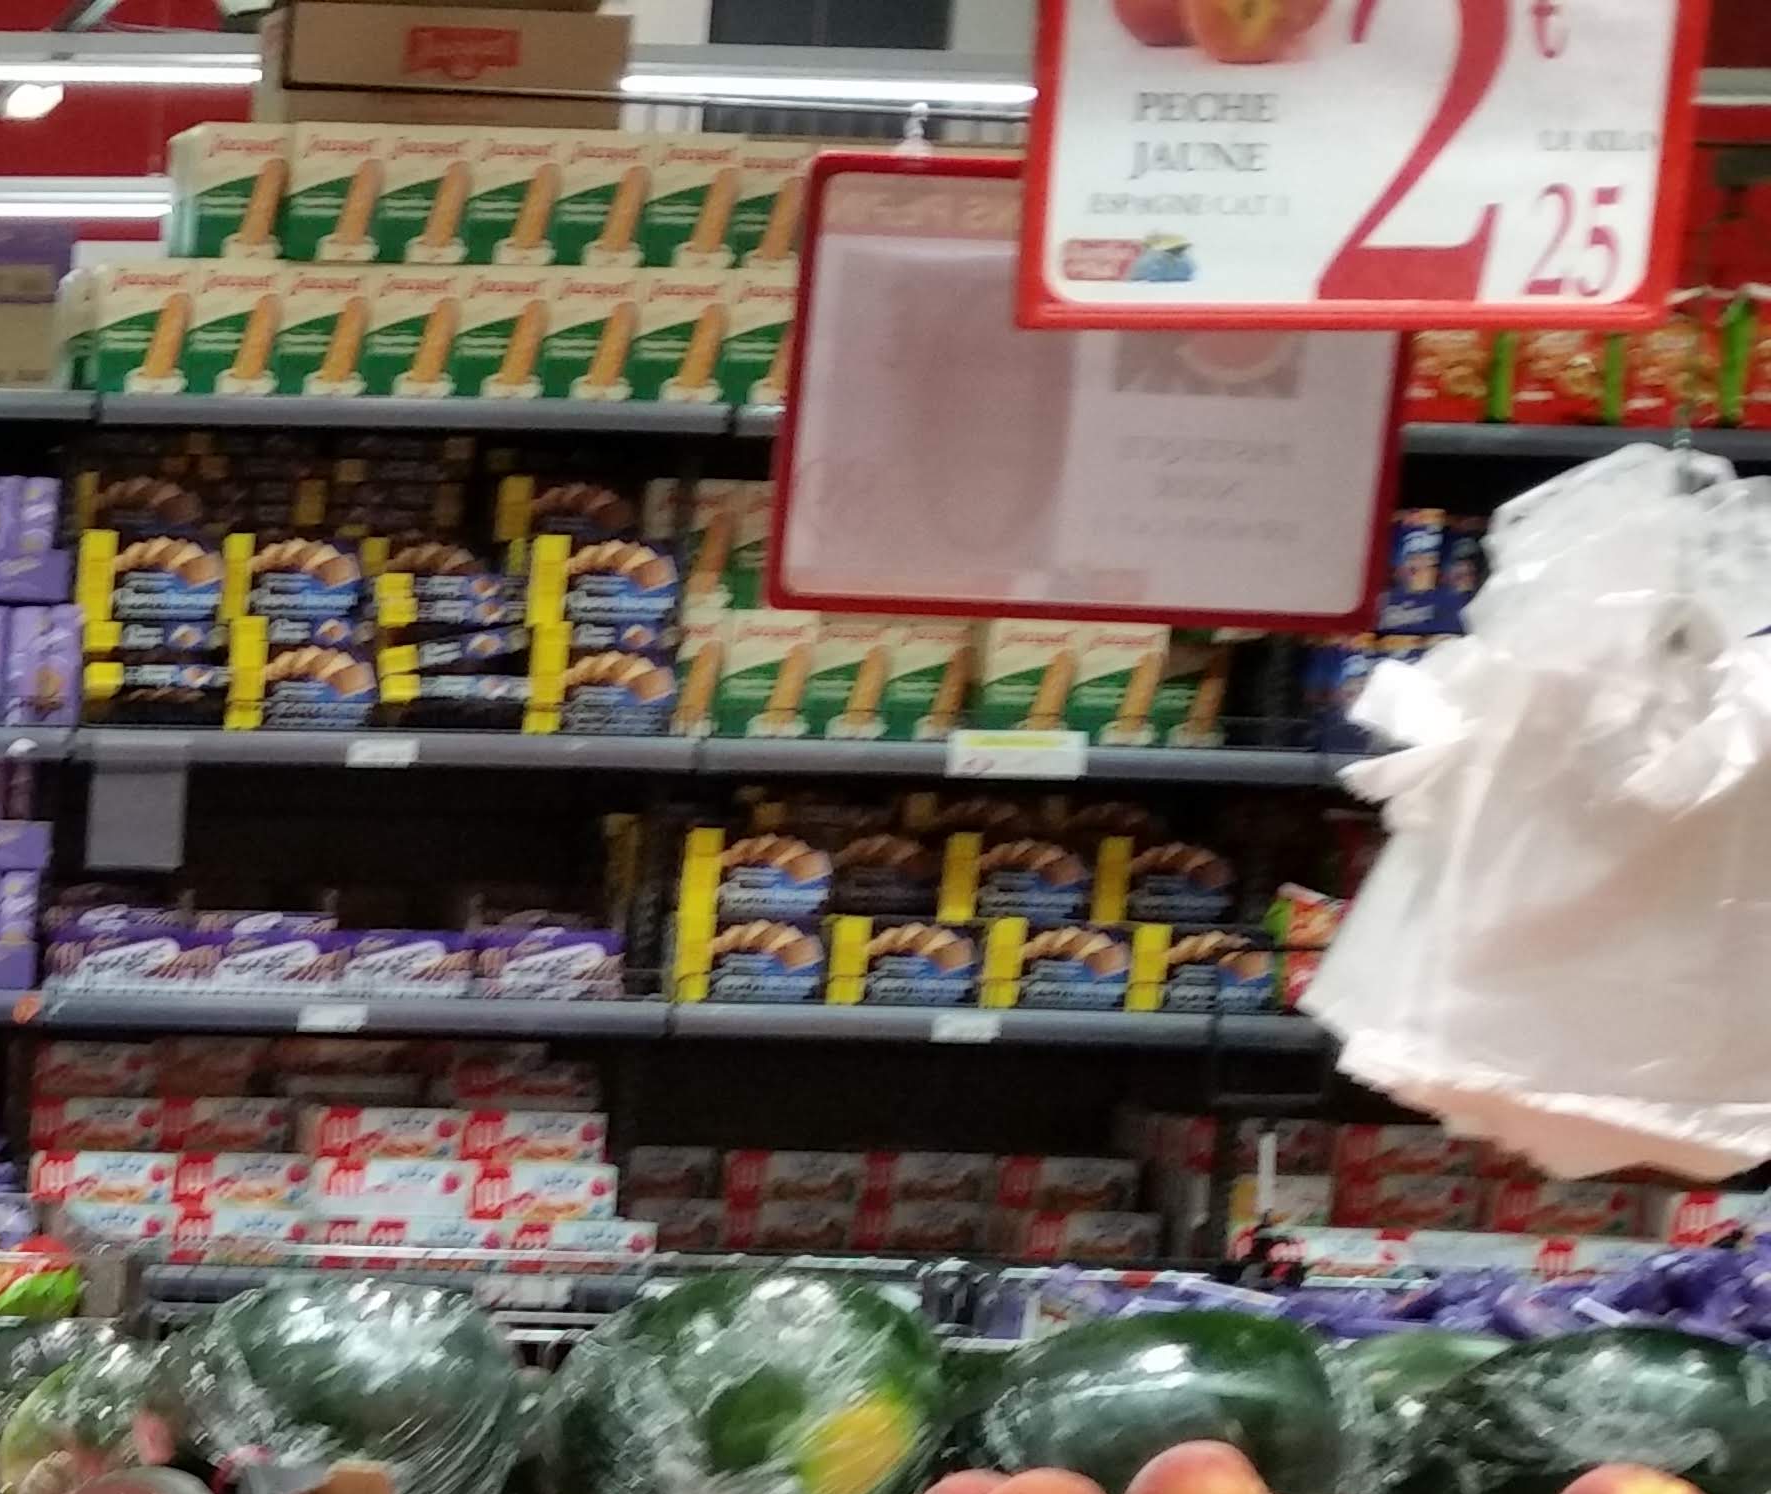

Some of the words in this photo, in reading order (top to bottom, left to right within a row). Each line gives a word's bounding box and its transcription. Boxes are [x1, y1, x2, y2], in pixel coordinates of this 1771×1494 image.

[1134, 91, 1279, 123] PECHE
[1128, 140, 1271, 180] JAUNE
[1318, 0, 1511, 300] 2
[1523, 182, 1622, 298] 25
